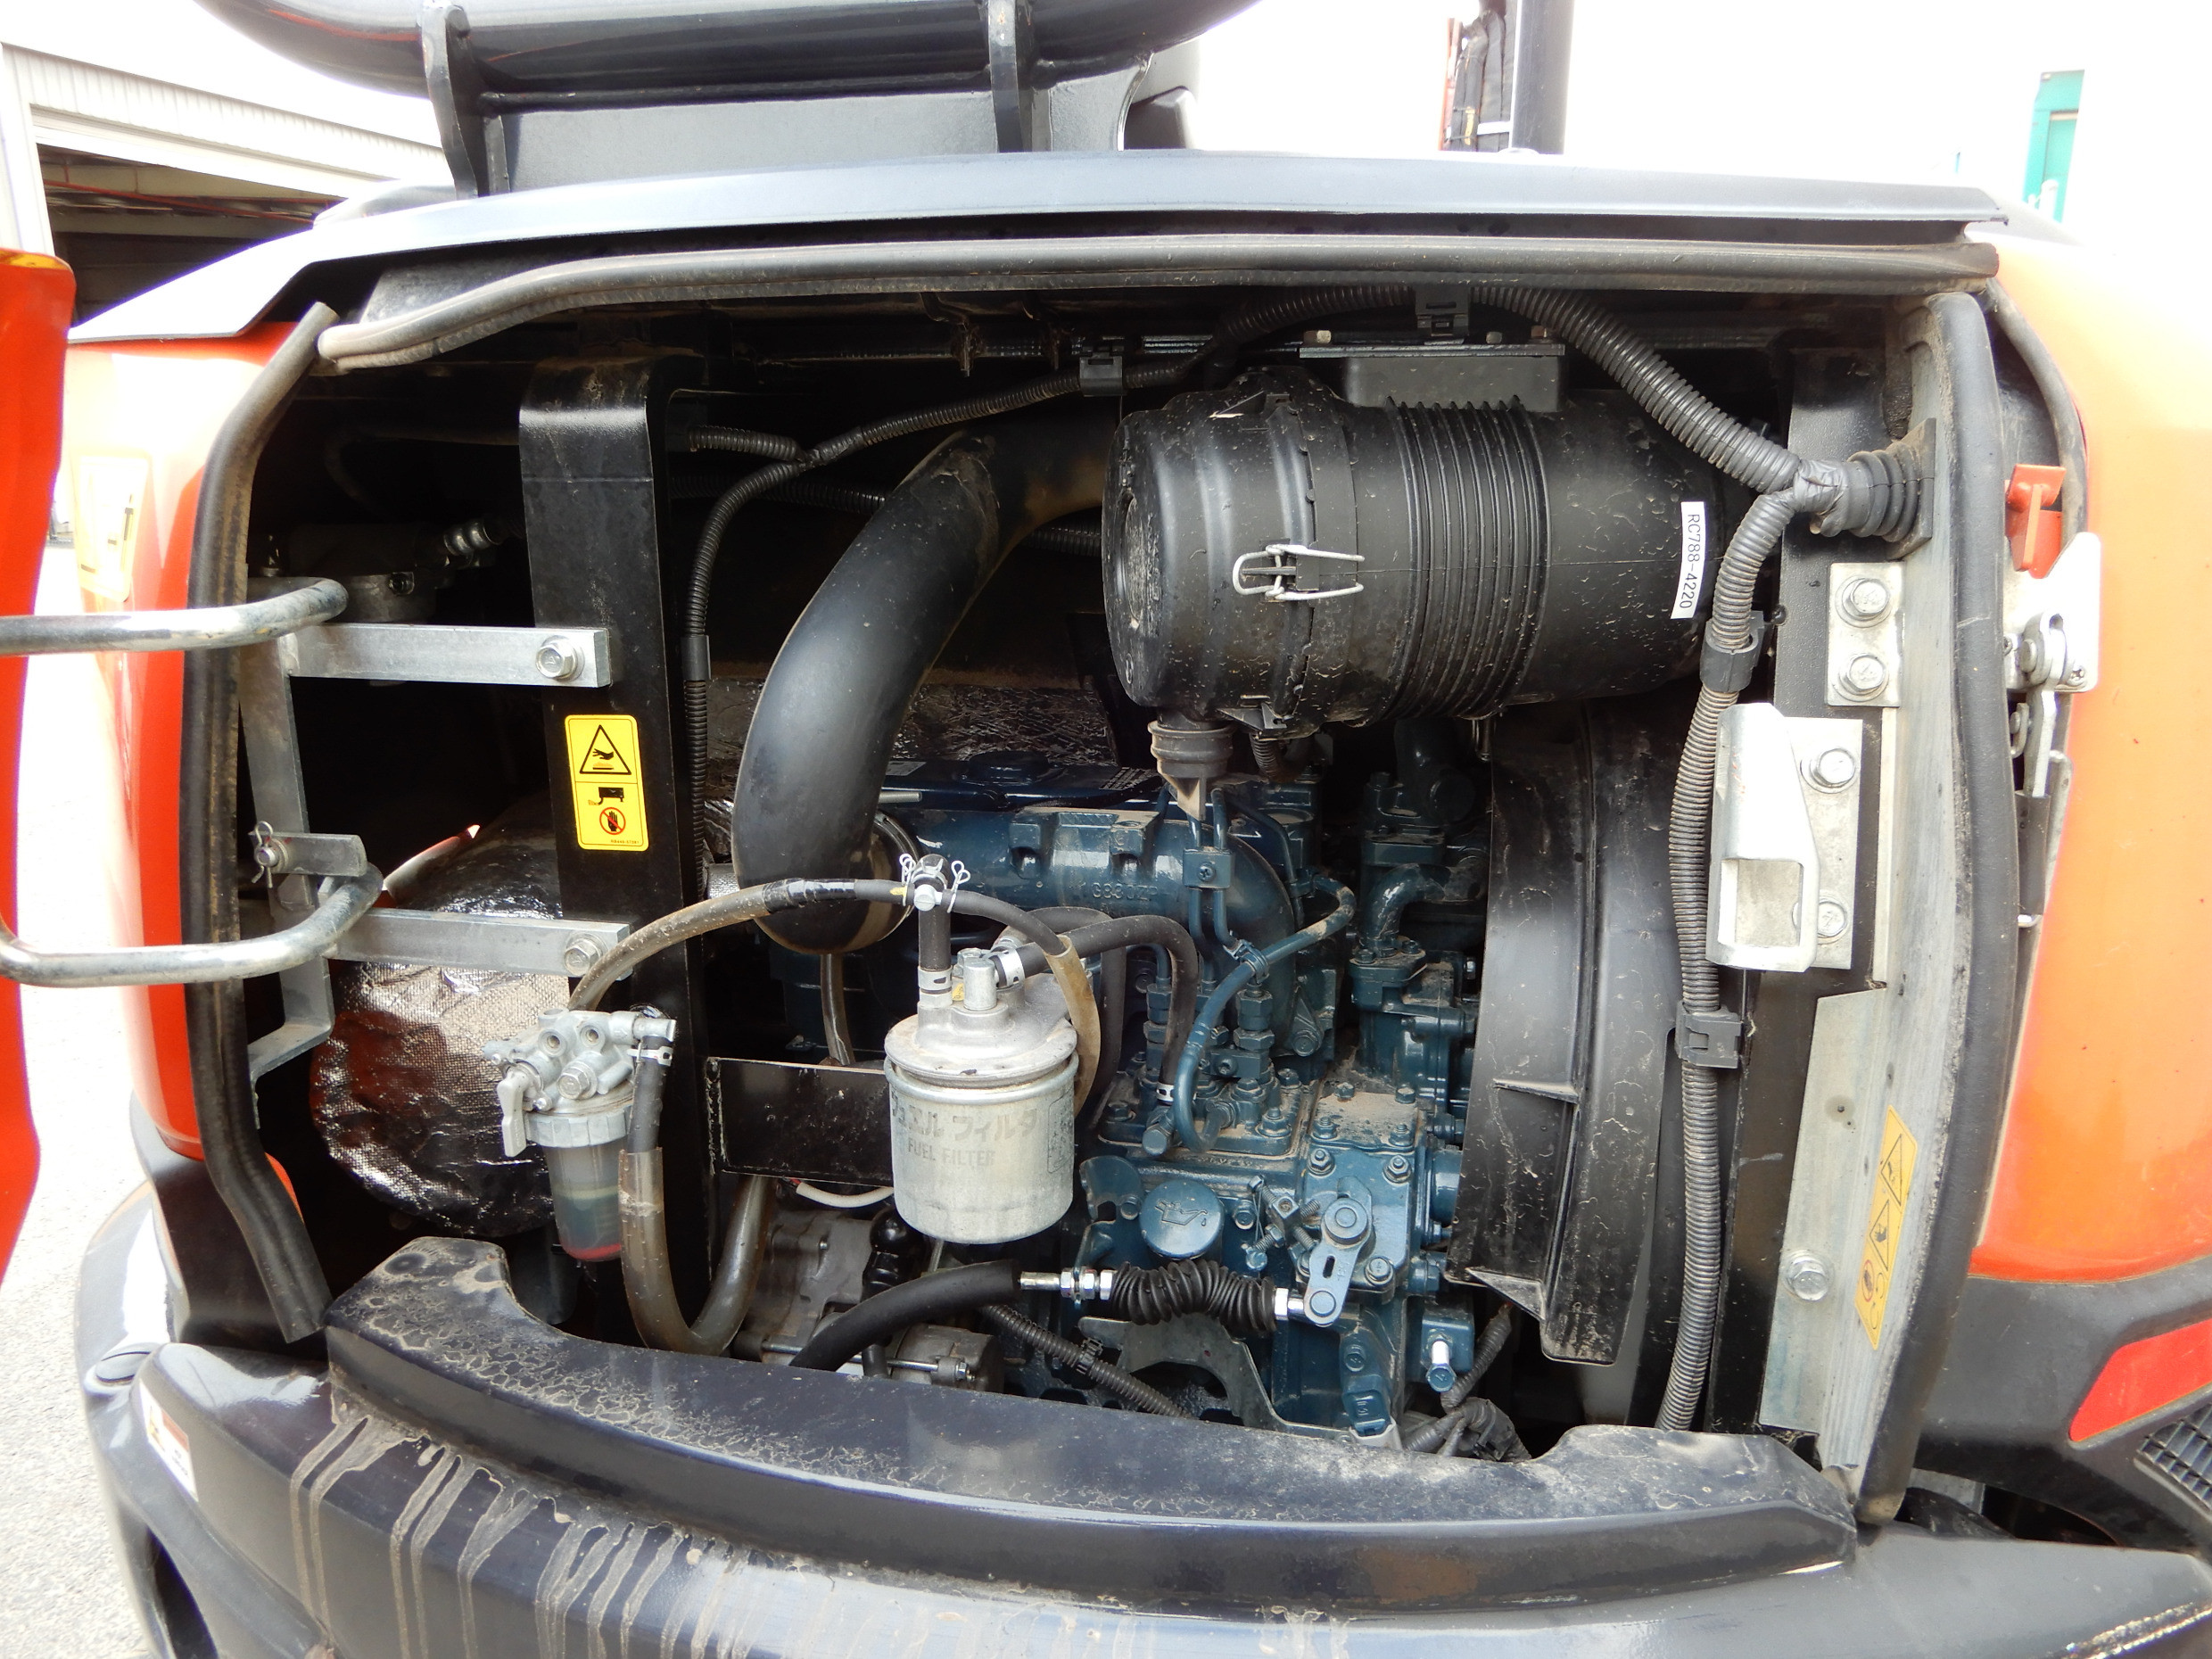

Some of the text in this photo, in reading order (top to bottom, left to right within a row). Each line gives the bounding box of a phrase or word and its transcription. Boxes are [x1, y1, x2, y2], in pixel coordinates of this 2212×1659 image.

[1680, 514, 1701, 609] RC788-4220
[952, 1108, 1038, 1143] フィルタ
[907, 1136, 996, 1168] FUEL FILTER
